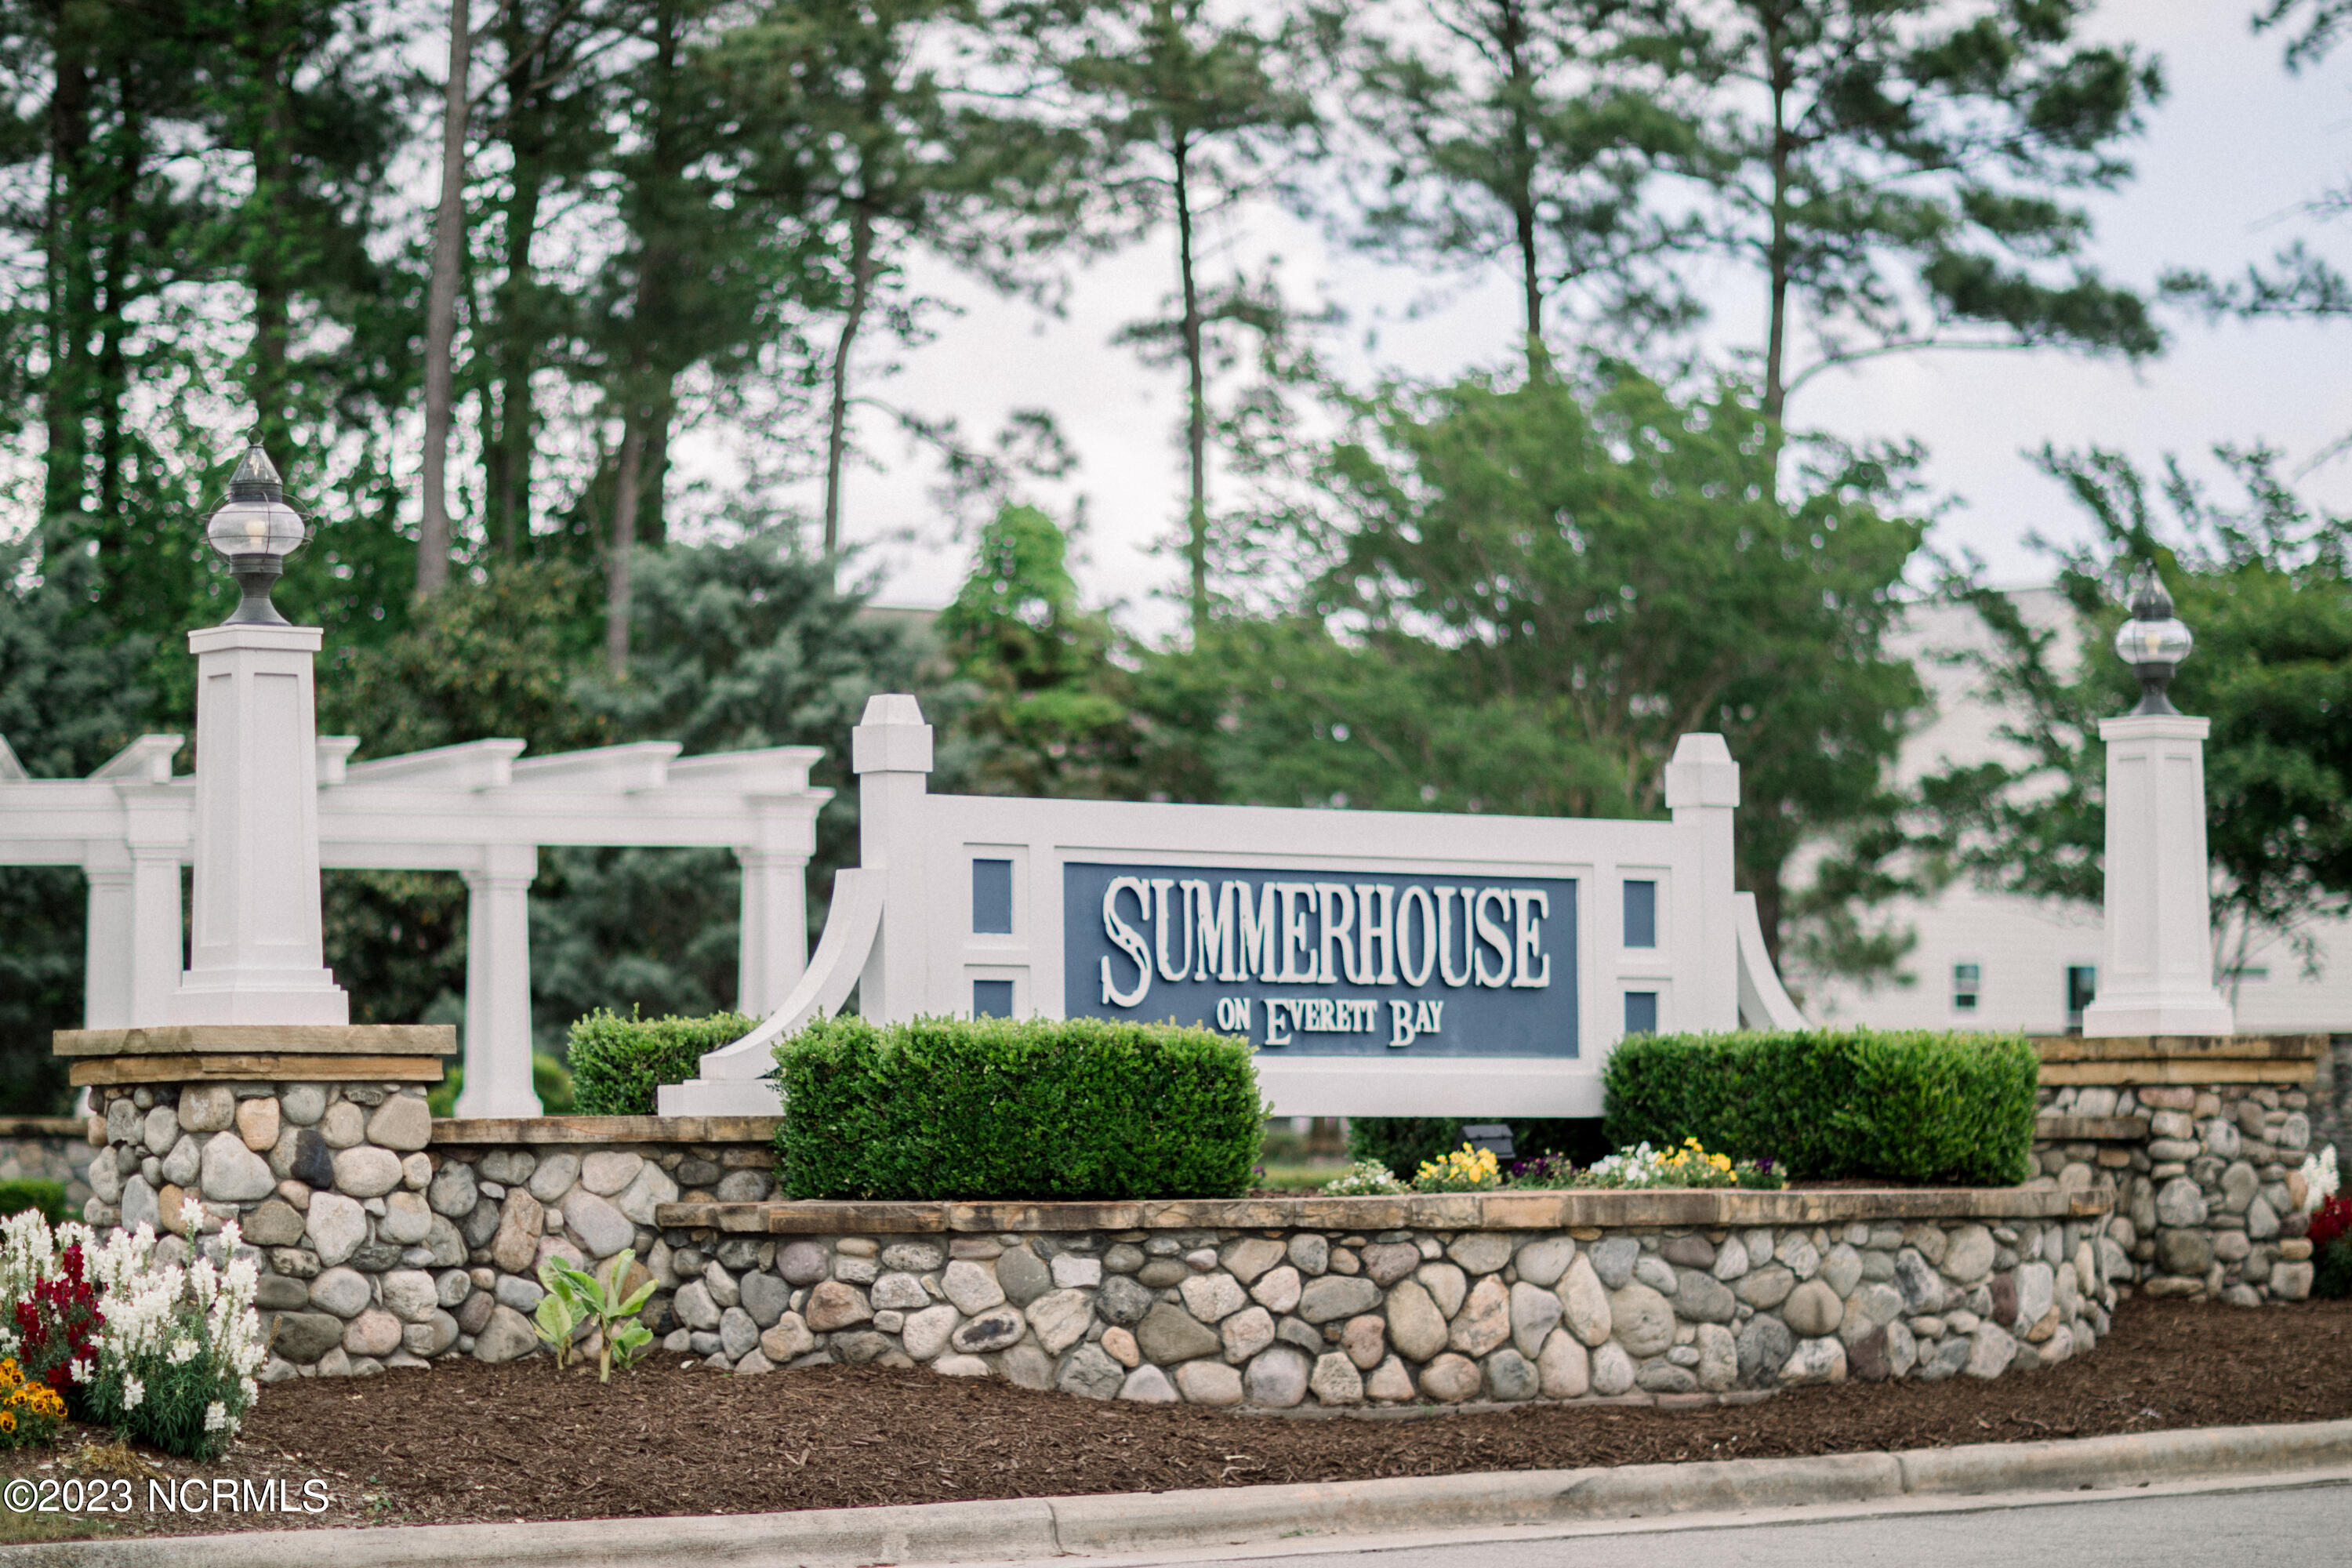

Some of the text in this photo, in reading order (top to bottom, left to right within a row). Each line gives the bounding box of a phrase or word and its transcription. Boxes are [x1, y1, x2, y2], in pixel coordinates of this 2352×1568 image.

[1101, 876, 1551, 1007] SUMMERHOUSE
[1217, 997, 1444, 1047] ON EVERETT BAY
